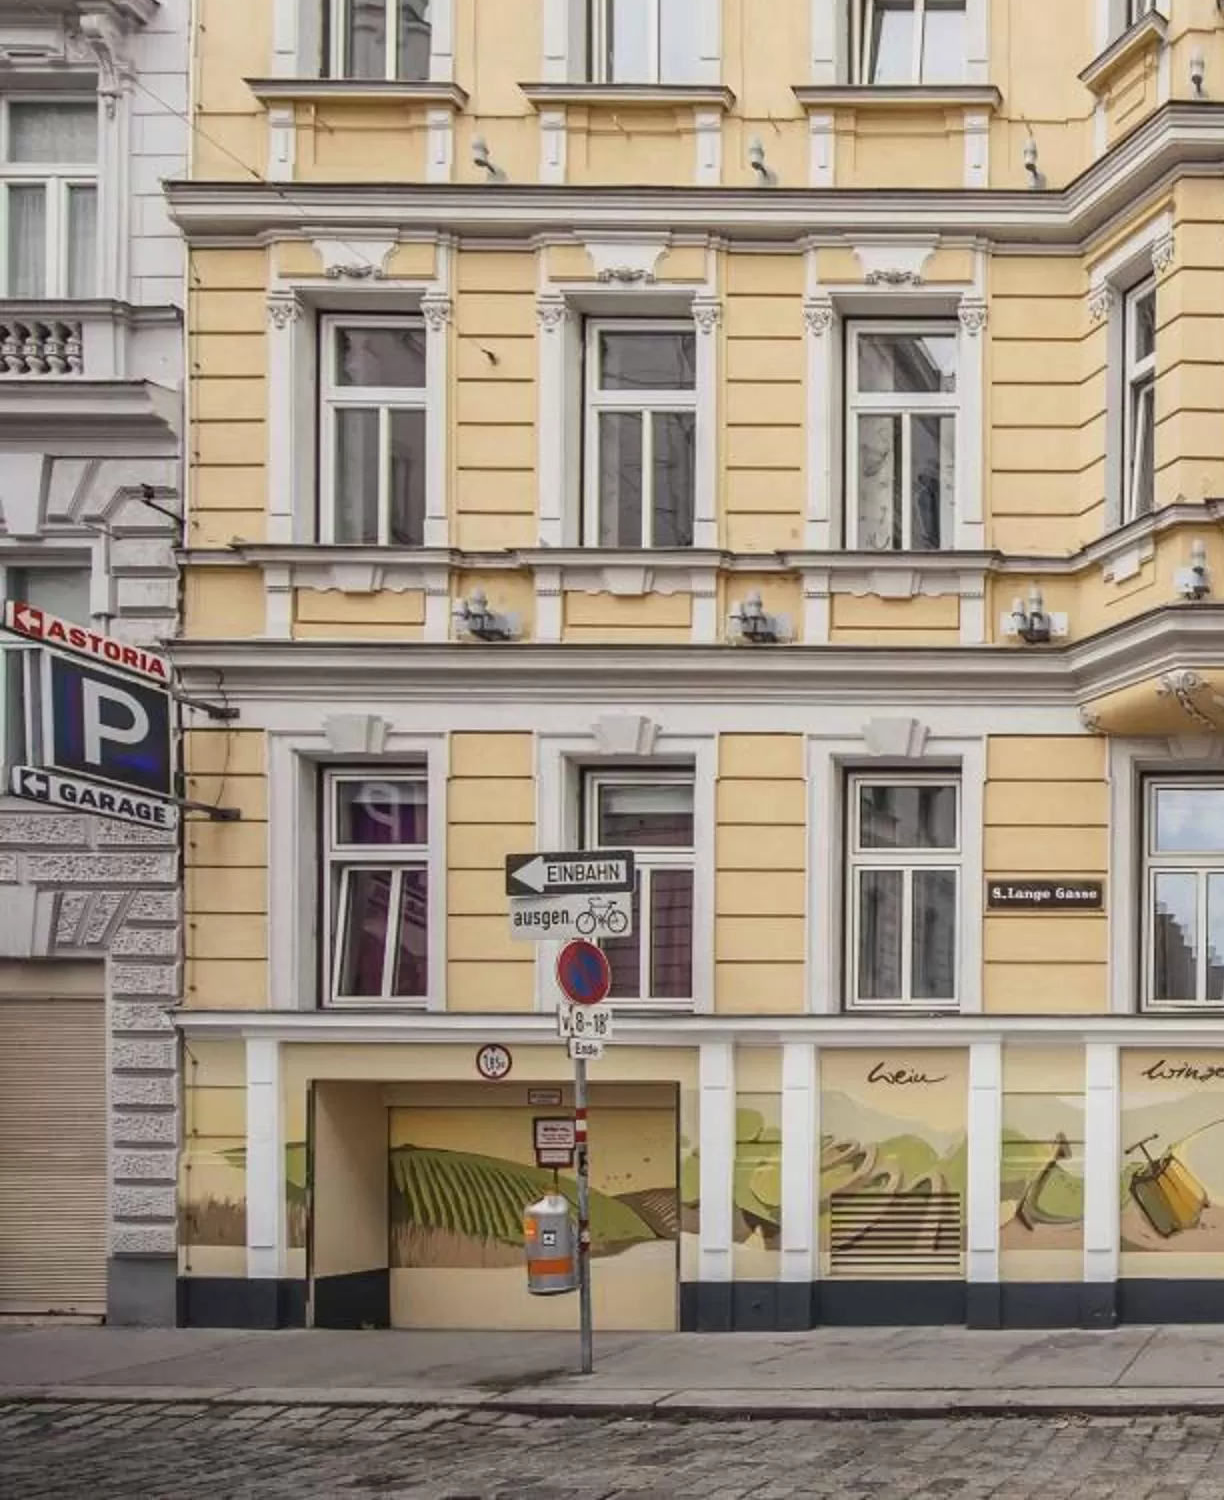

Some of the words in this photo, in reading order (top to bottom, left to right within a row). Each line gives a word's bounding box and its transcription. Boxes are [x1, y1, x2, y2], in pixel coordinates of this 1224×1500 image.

[49, 620, 165, 677] ASTORIA
[82, 677, 149, 765] P
[58, 782, 167, 824] GARAGE
[547, 863, 620, 882] EINBAHN
[1055, 887, 1098, 899] Gasse
